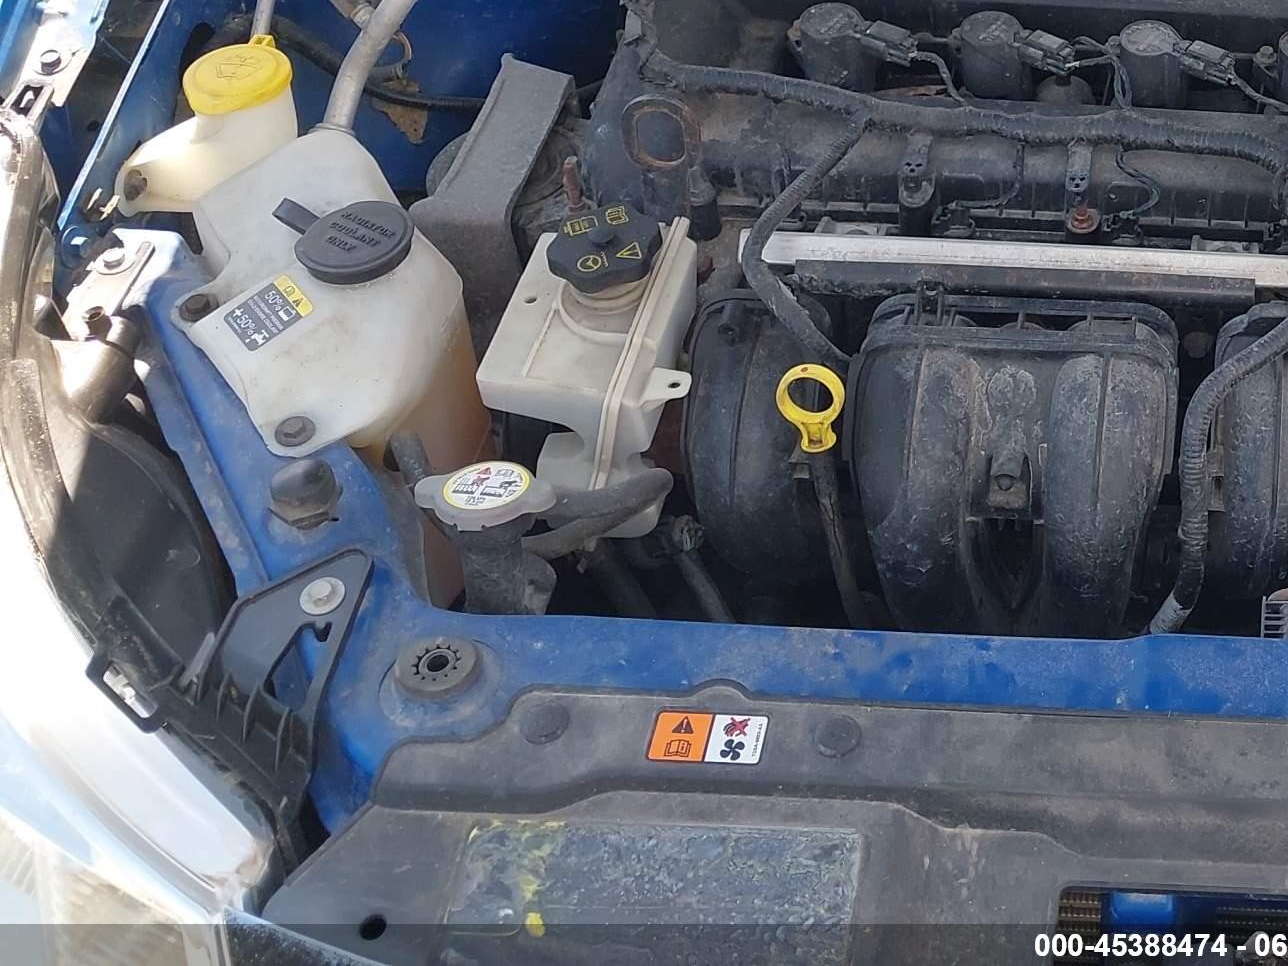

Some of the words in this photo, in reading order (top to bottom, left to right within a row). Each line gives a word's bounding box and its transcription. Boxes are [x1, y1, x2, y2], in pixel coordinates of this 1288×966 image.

[328, 221, 382, 248] COOLANT
[341, 211, 396, 239] RADIATOR
[325, 235, 357, 251] ONLY
[264, 290, 284, 312] 50%
